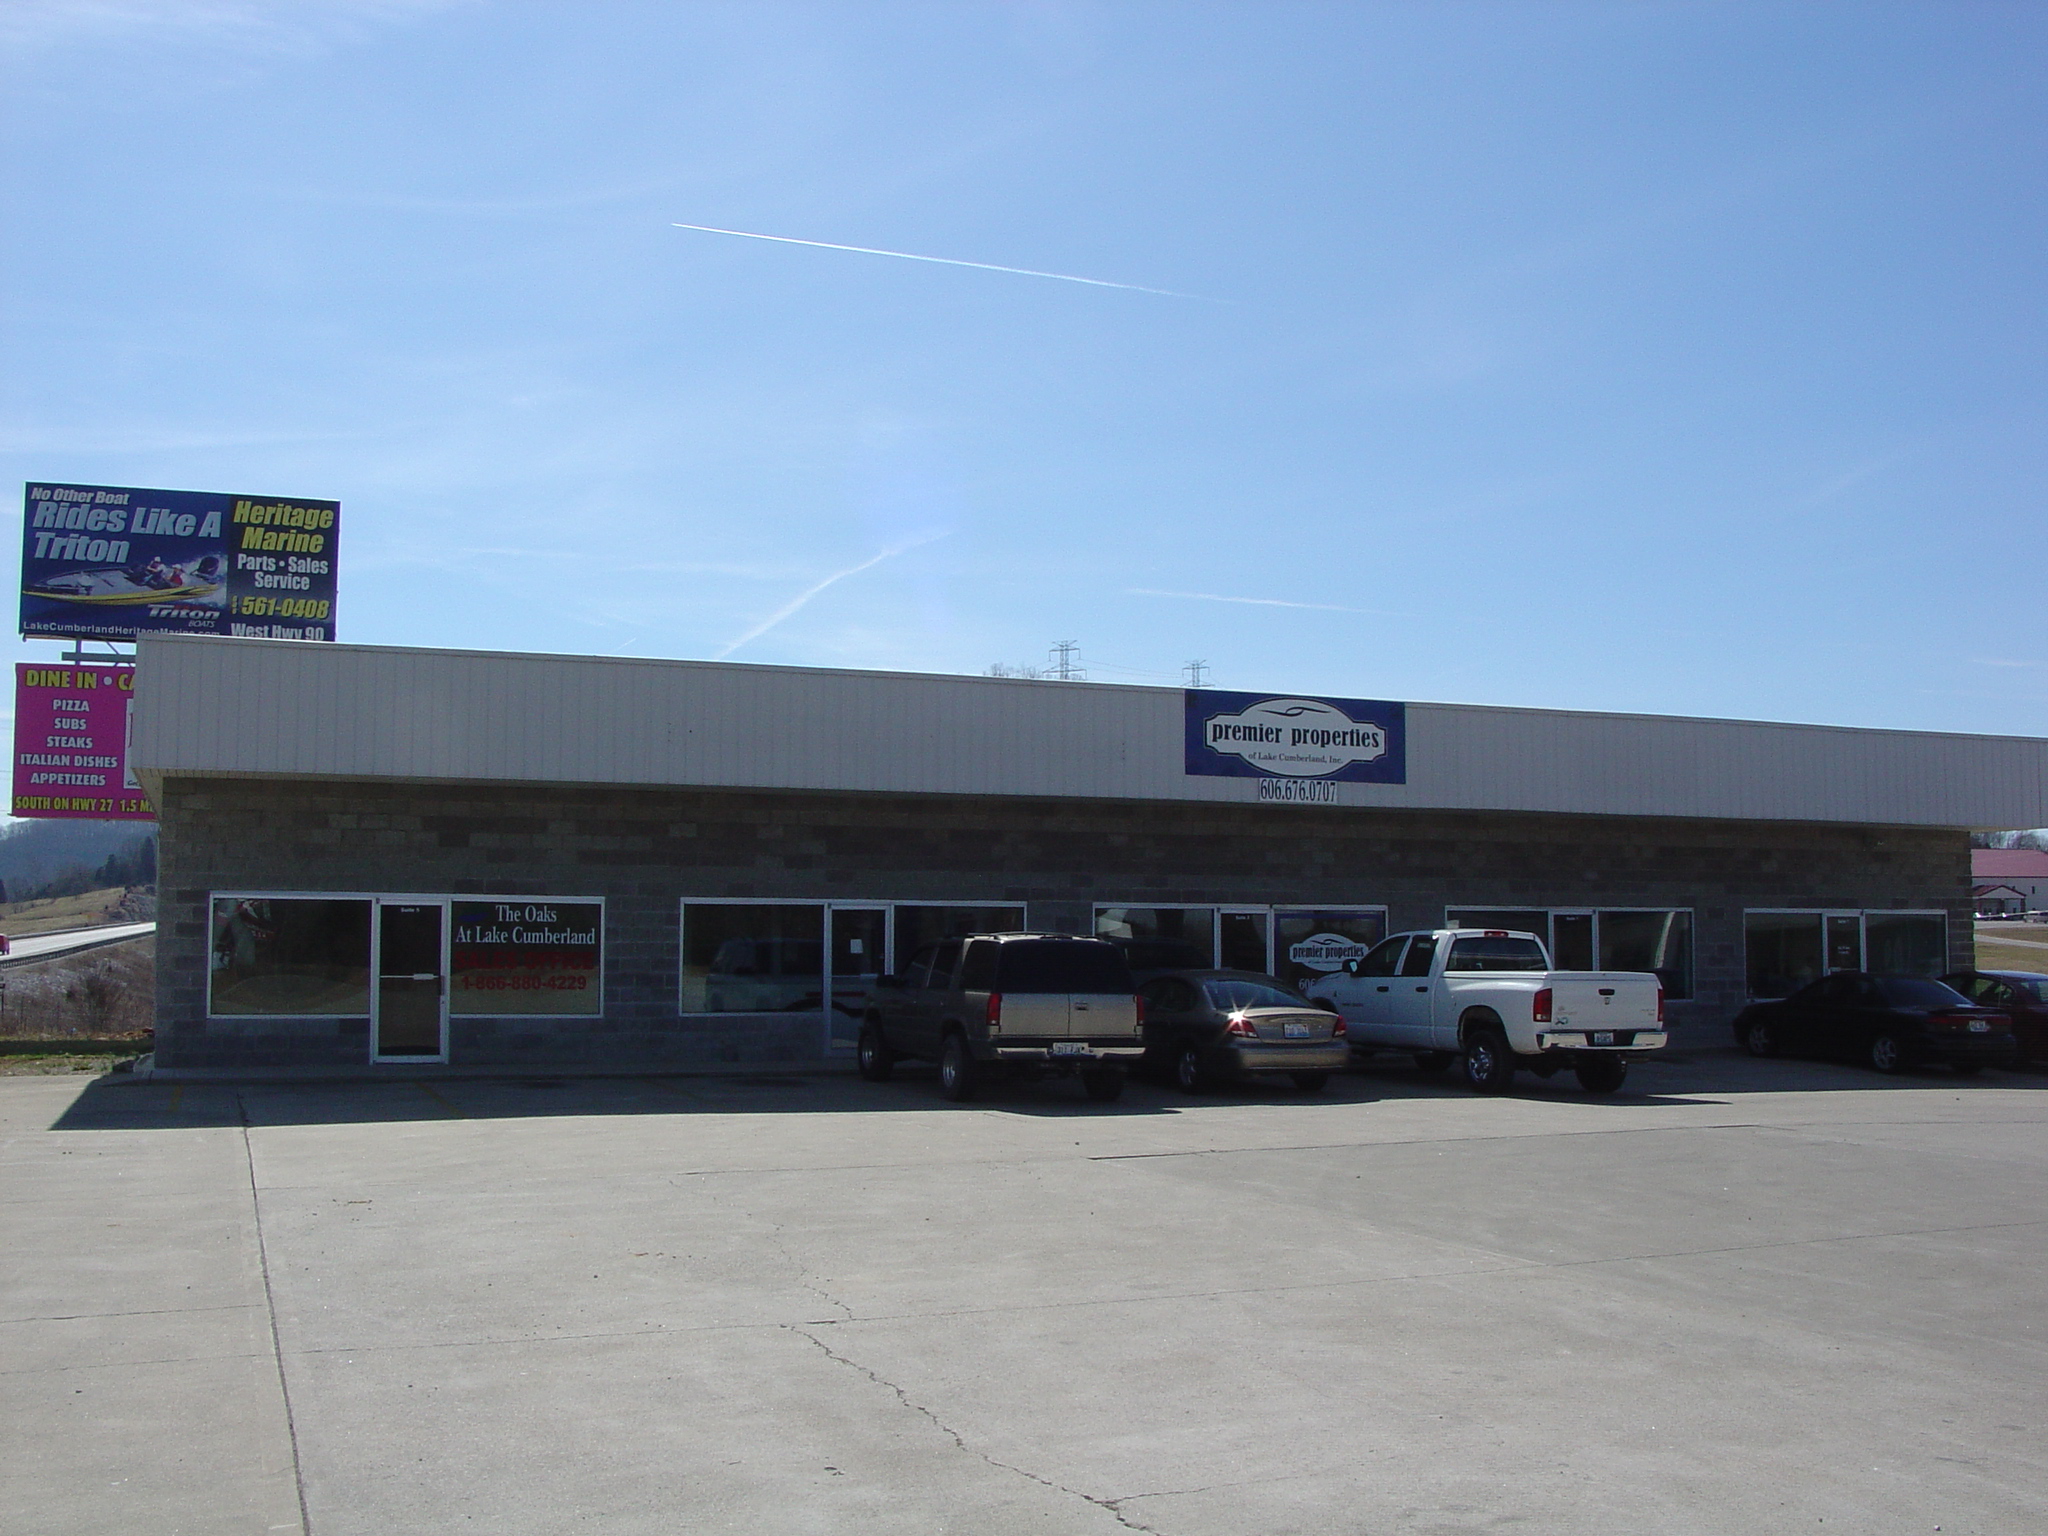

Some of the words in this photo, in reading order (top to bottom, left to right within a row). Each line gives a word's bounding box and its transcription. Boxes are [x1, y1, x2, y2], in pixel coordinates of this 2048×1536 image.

[31, 487, 50, 500] No
[53, 488, 94, 503] Other
[96, 490, 129, 505] Boat
[33, 501, 126, 532] Rides
[131, 507, 196, 537] Like
[198, 511, 222, 538] A
[234, 501, 333, 529] Heritage
[34, 532, 130, 563] Triton
[242, 527, 324, 553] Marine
[237, 553, 276, 572] Parts
[288, 557, 328, 574] Sales
[254, 572, 310, 590] Service
[147, 604, 220, 619] Triton
[241, 596, 330, 619] 561-0408
[23, 621, 220, 636] LakeCumberlandHeritageMarinecom
[188, 620, 215, 629] BOATS
[231, 623, 269, 638] West
[272, 625, 302, 639] Hwy
[305, 627, 325, 640] 90
[25, 670, 70, 688] DINE
[77, 672, 97, 689] IN
[53, 700, 90, 712] PIZZA
[54, 718, 86, 730] SUBS
[47, 736, 93, 749] STEAKS
[1212, 723, 1282, 743] premier
[1291, 727, 1379, 748] properties
[20, 754, 70, 766] ITALIAN
[74, 756, 118, 768] DISHES
[1248, 752, 1256, 760] of
[1258, 752, 1277, 760] Lake
[1279, 753, 1327, 763] Cumberland,
[1329, 755, 1343, 764] Inc.
[30, 772, 106, 786] APPETIZERS
[1261, 779, 1336, 802] 606.676.0707
[15, 796, 50, 810] SOUTH
[53, 797, 69, 810] ON
[72, 798, 96, 811] HWY
[100, 799, 113, 811] 27
[120, 799, 137, 812] 1.5
[495, 905, 521, 922] The
[525, 906, 557, 923] Oaks
[456, 927, 472, 943] At
[476, 926, 509, 943] Lake
[512, 926, 596, 944] Cumberland
[453, 950, 517, 970] SALES
[523, 951, 596, 970] OFFICE
[1293, 945, 1323, 959] premier
[1325, 945, 1364, 959] properties
